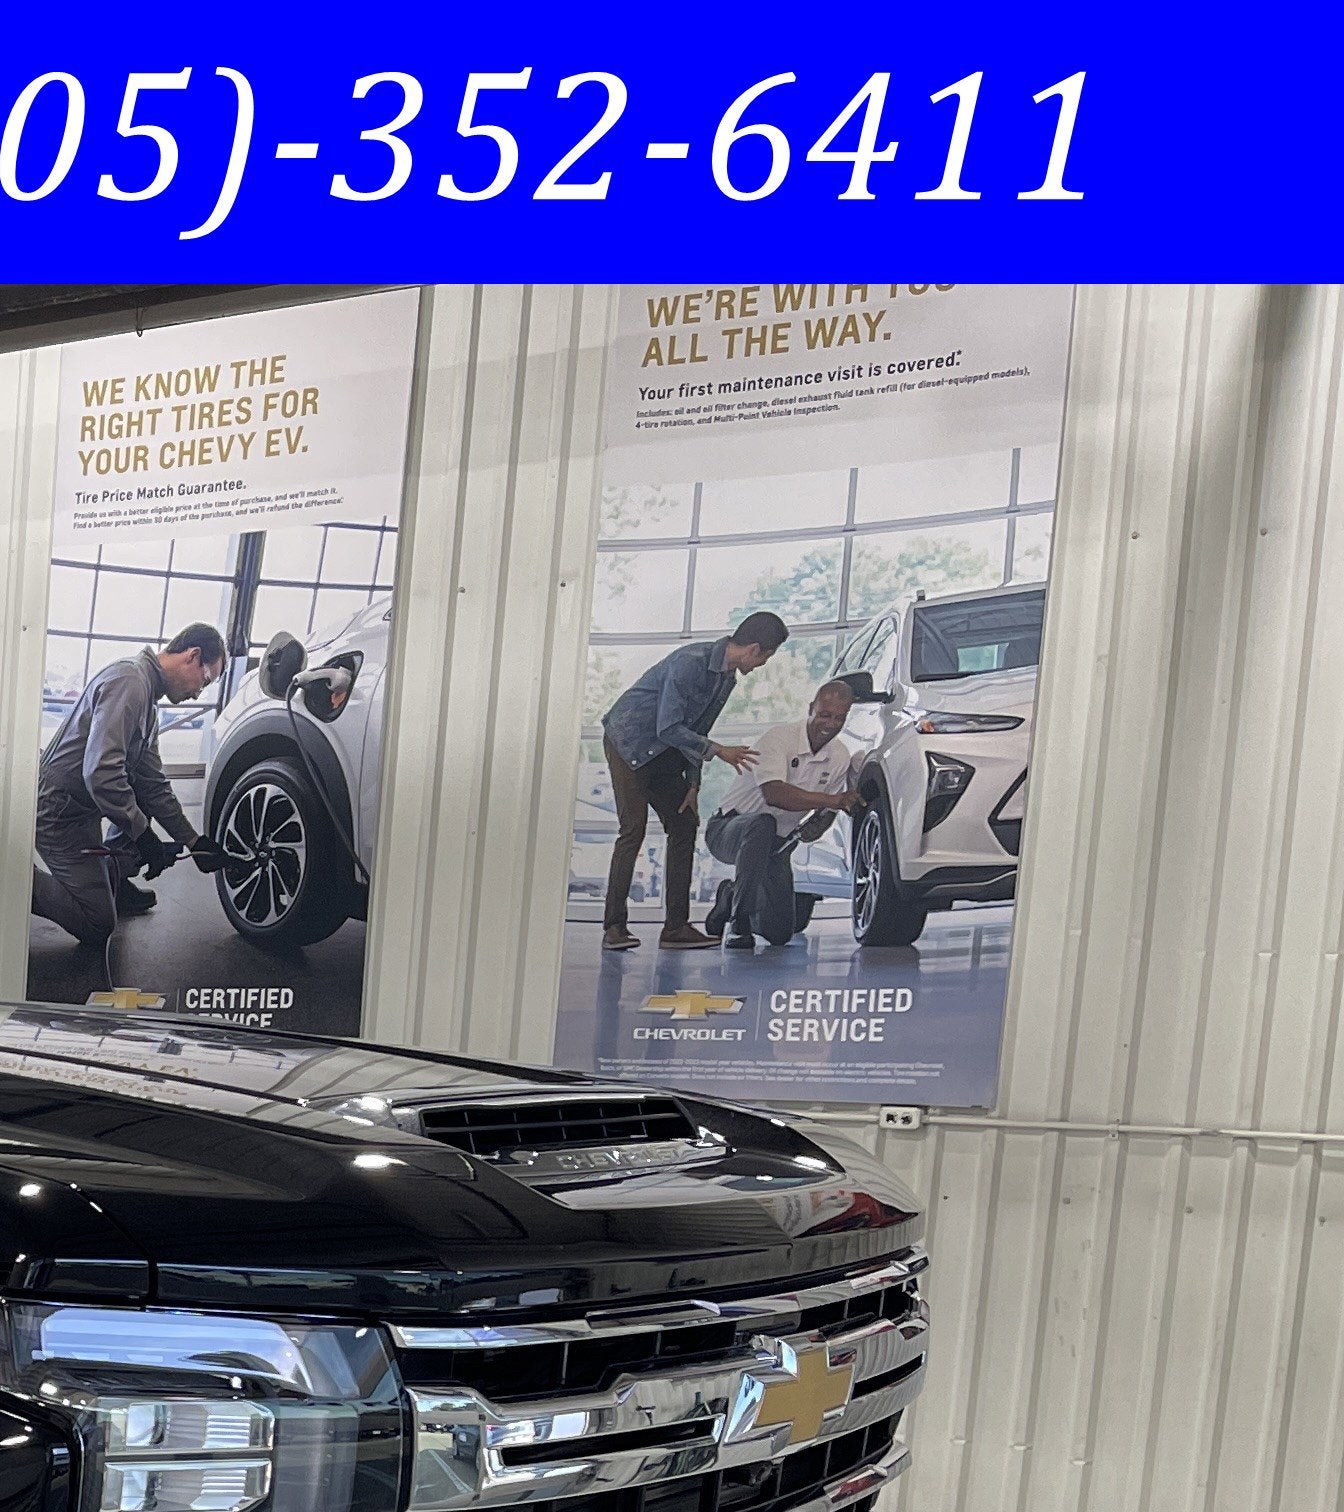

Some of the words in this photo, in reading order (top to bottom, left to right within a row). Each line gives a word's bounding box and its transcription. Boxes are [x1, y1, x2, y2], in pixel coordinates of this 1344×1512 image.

[647, 285, 760, 328] WE'RE
[641, 333, 708, 367] ALL
[721, 322, 792, 359] THE
[804, 310, 892, 350] WAY.
[83, 377, 126, 407] WE
[135, 365, 220, 402] KNOW
[230, 355, 287, 390] THE
[638, 386, 674, 401] Your
[678, 382, 713, 397] first
[718, 372, 823, 394] maintenance
[827, 365, 863, 381] visit
[868, 362, 882, 377] is
[686, 405, 701, 414] and
[798, 393, 832, 403] exhaust
[833, 390, 853, 399] fluid
[855, 387, 874, 397] tank
[877, 383, 898, 394] refill
[80, 408, 161, 442] RIGHT
[172, 398, 252, 433] TIRES
[263, 387, 320, 422] FOR
[697, 416, 712, 424] and
[77, 444, 149, 476] YOUR
[159, 431, 257, 468] CHEVY
[265, 425, 309, 458] EV.
[75, 491, 99, 504] Tire
[101, 488, 133, 502] Price
[136, 484, 174, 500] Match
[177, 480, 247, 496] Guarantee.
[108, 509, 122, 517] with
[129, 508, 148, 516] better
[175, 504, 192, 513] price
[193, 502, 201, 510] at
[202, 501, 213, 509] the
[275, 493, 287, 501] and
[306, 488, 329, 497] match
[73, 522, 86, 530] Find
[115, 519, 131, 527] price
[163, 514, 179, 523] days
[180, 513, 188, 521] of
[189, 512, 199, 520] the
[235, 508, 248, 516] and
[291, 501, 303, 510] the
[185, 987, 294, 1009] CERTIFIED
[769, 987, 913, 1014] CERTIFIED
[632, 1028, 747, 1042] CHEVROLET
[767, 1017, 886, 1043] SERVICE
